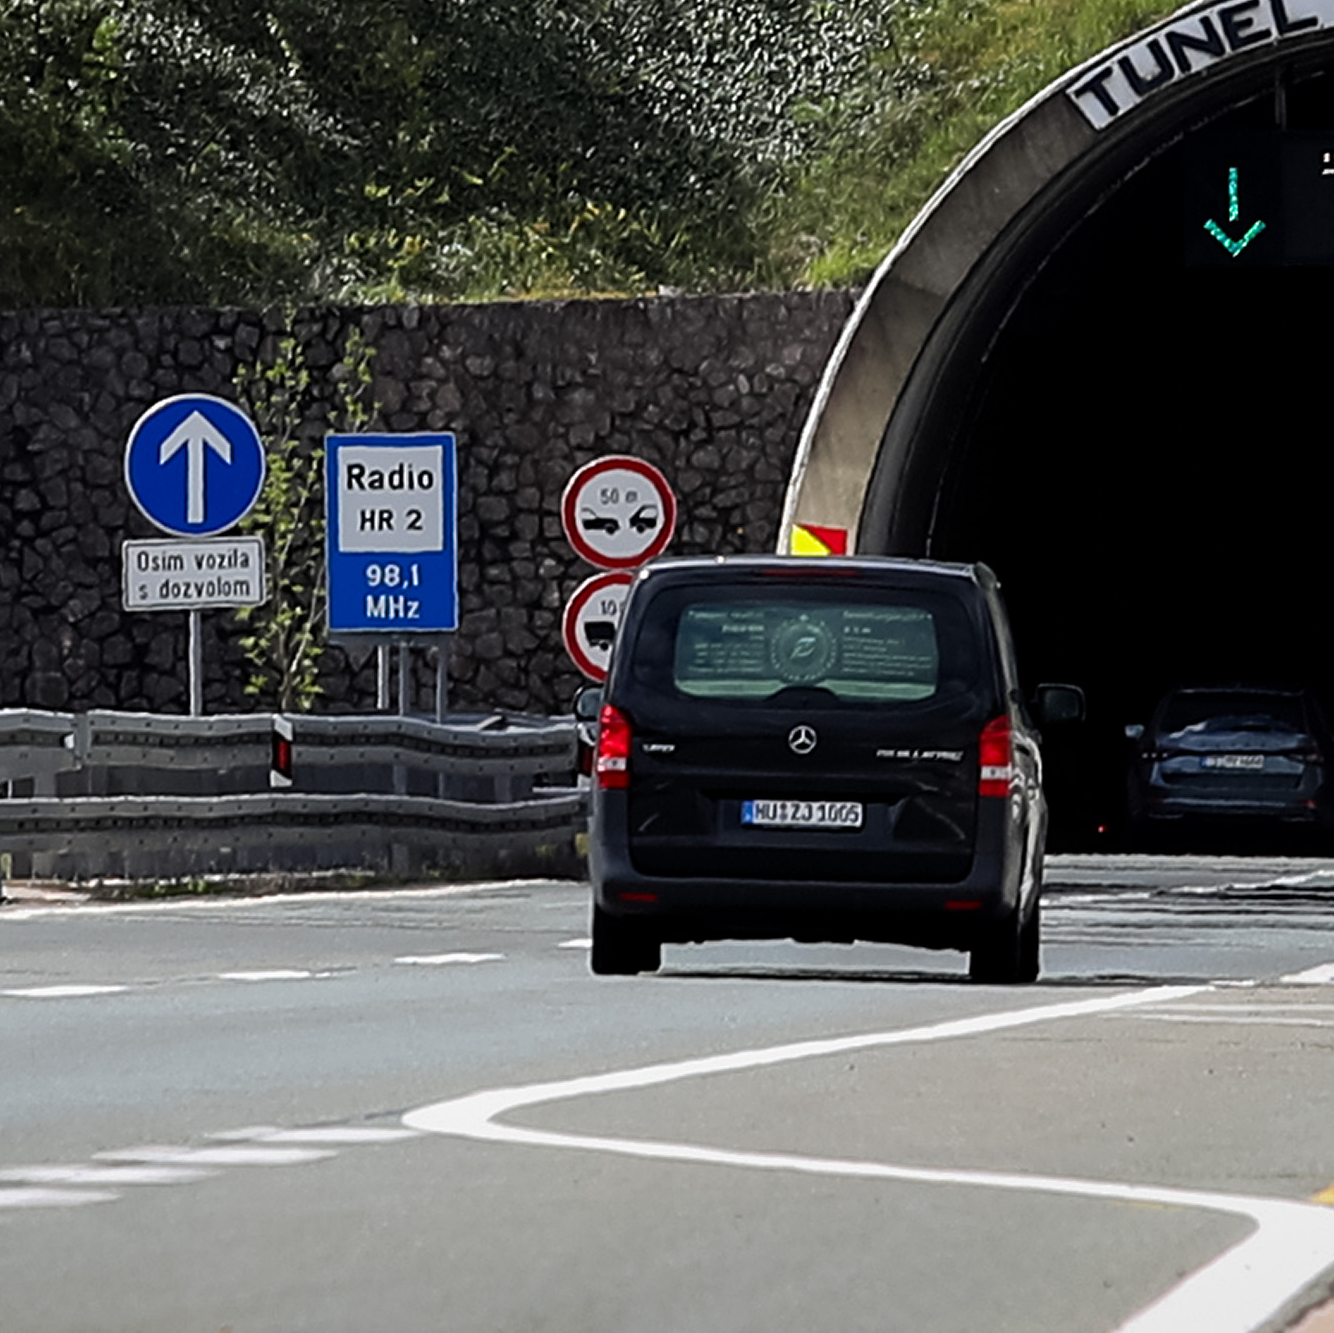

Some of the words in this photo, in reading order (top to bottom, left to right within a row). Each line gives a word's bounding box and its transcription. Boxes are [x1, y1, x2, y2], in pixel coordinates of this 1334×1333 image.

[346, 463, 434, 490] Radio
[599, 488, 618, 505] 50
[359, 509, 394, 532] HR
[405, 509, 423, 532] 2
[137, 550, 185, 572] Osim
[194, 547, 250, 571] vozila
[138, 583, 149, 601] s
[159, 575, 251, 599] dozvolom
[366, 563, 420, 590] 98,1
[365, 594, 421, 619] MHz
